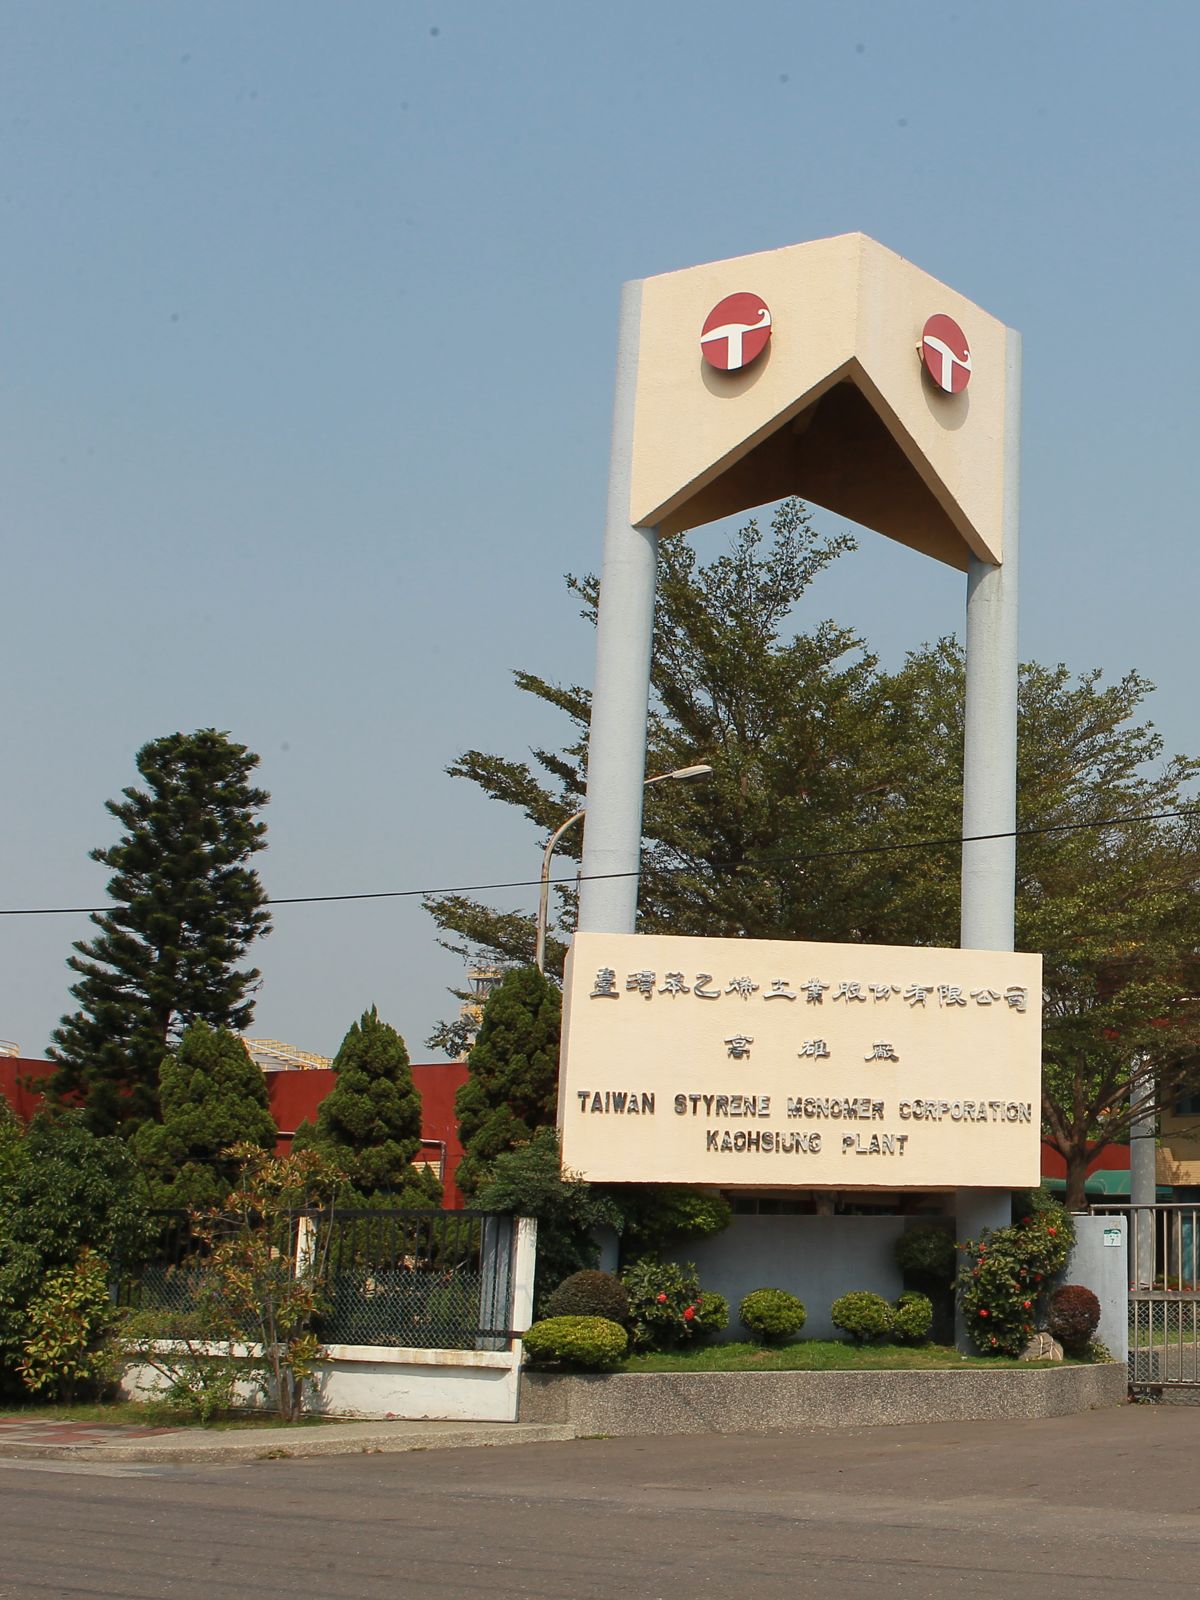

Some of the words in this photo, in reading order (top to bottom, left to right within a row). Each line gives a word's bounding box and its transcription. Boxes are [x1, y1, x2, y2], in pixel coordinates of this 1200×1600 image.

[577, 1090, 655, 1115] TAIWAN
[674, 1094, 771, 1118] STYRENE
[787, 1097, 885, 1121] MONOMER
[899, 1099, 1032, 1124] CORPORATION
[706, 1130, 822, 1155] KAOHSIUNG
[842, 1132, 908, 1156] PLANT
